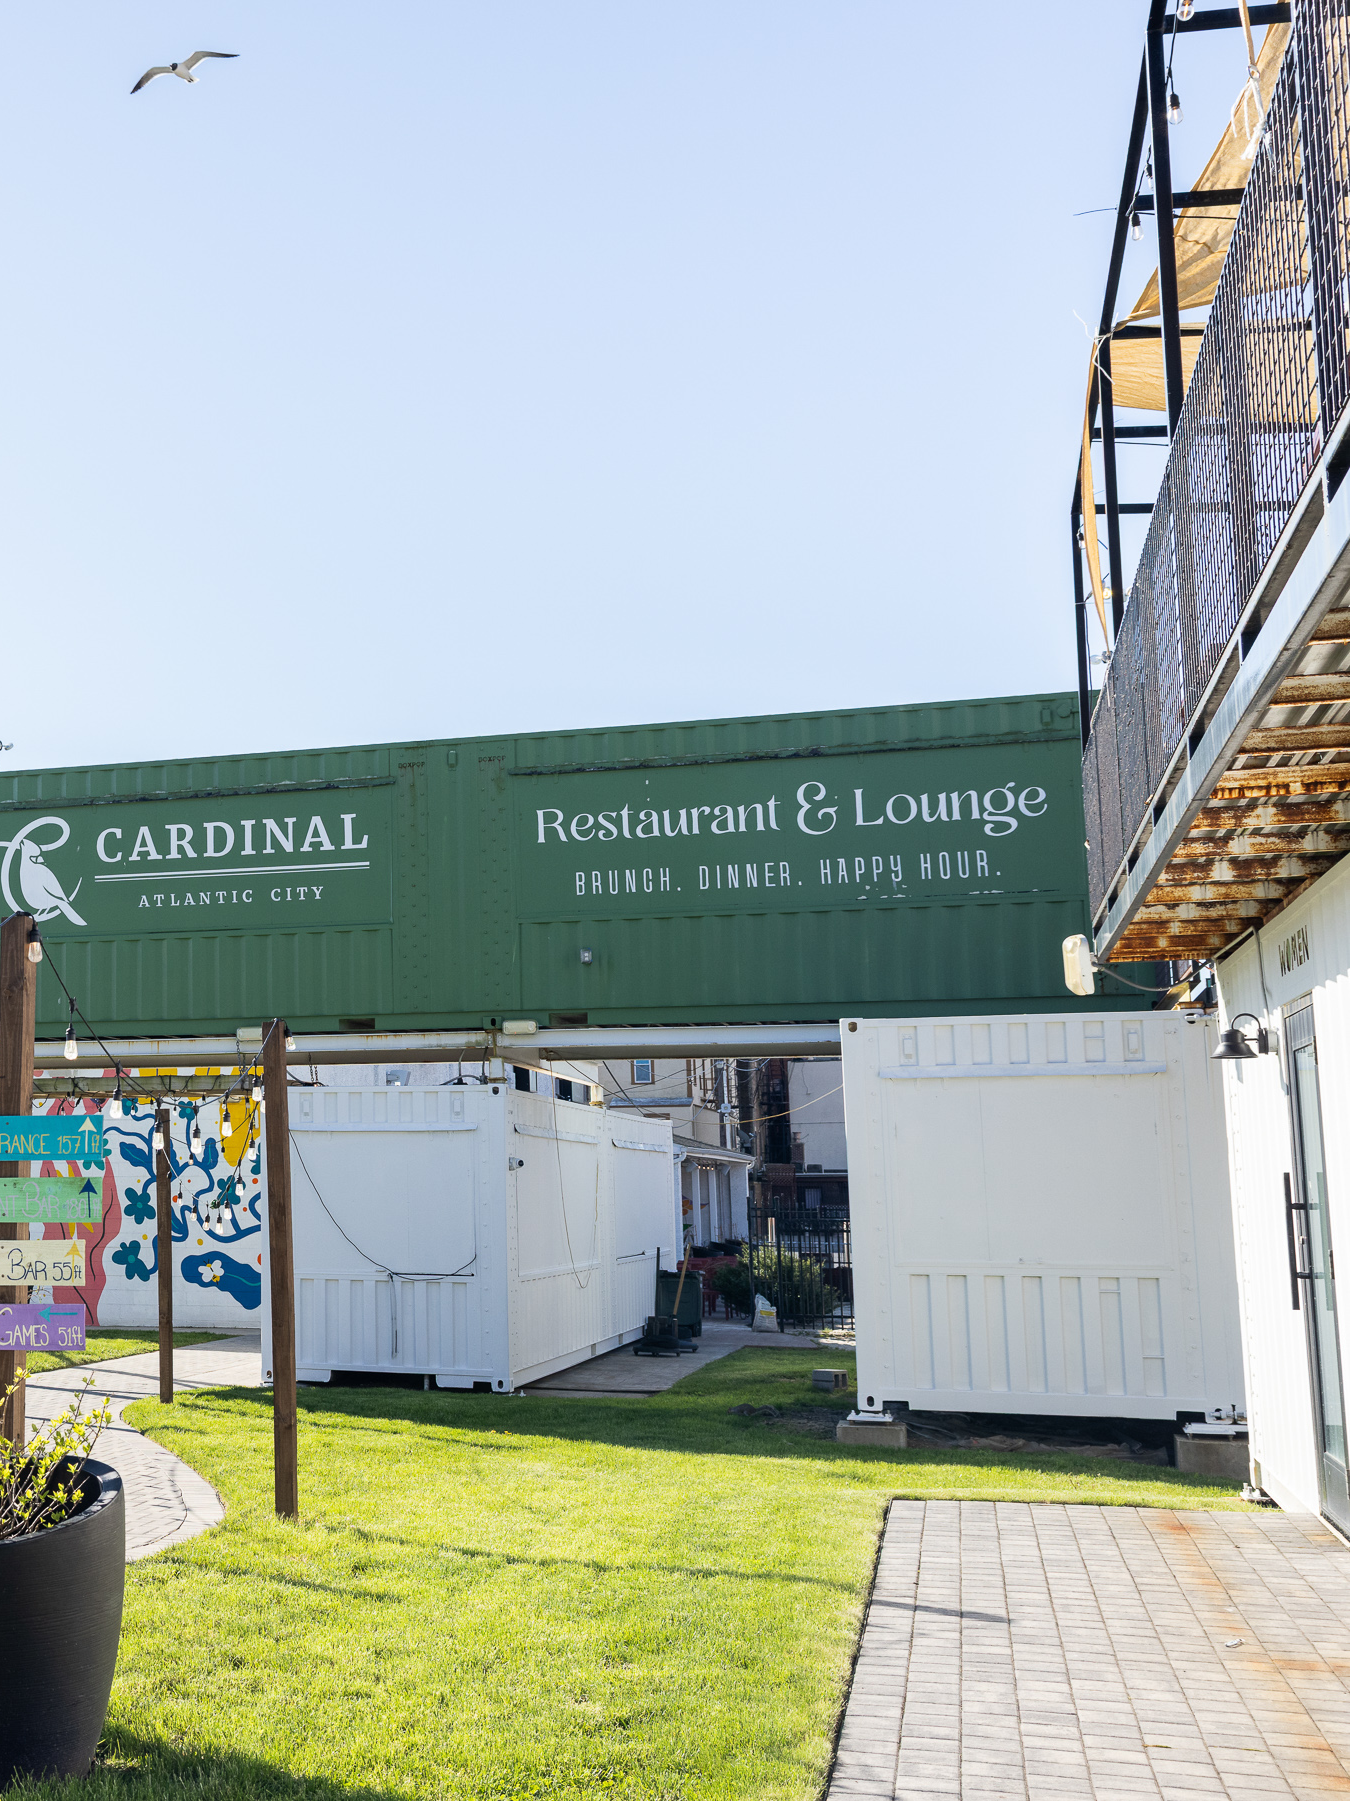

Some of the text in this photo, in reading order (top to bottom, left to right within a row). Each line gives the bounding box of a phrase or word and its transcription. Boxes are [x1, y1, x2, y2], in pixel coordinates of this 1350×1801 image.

[536, 780, 1048, 844] Restaurant & Lounge
[96, 813, 370, 864] CARDINAL
[575, 849, 1002, 896] BRUNCH. DINNER. HAPPY HOUR.
[138, 886, 325, 908] ATLANTIC CITY
[1278, 924, 1310, 977] WOMEN
[57, 1135, 81, 1155] 157
[21, 1181, 60, 1218] BAR
[66, 1198, 87, 1219] 180
[6, 1247, 48, 1281] BAR
